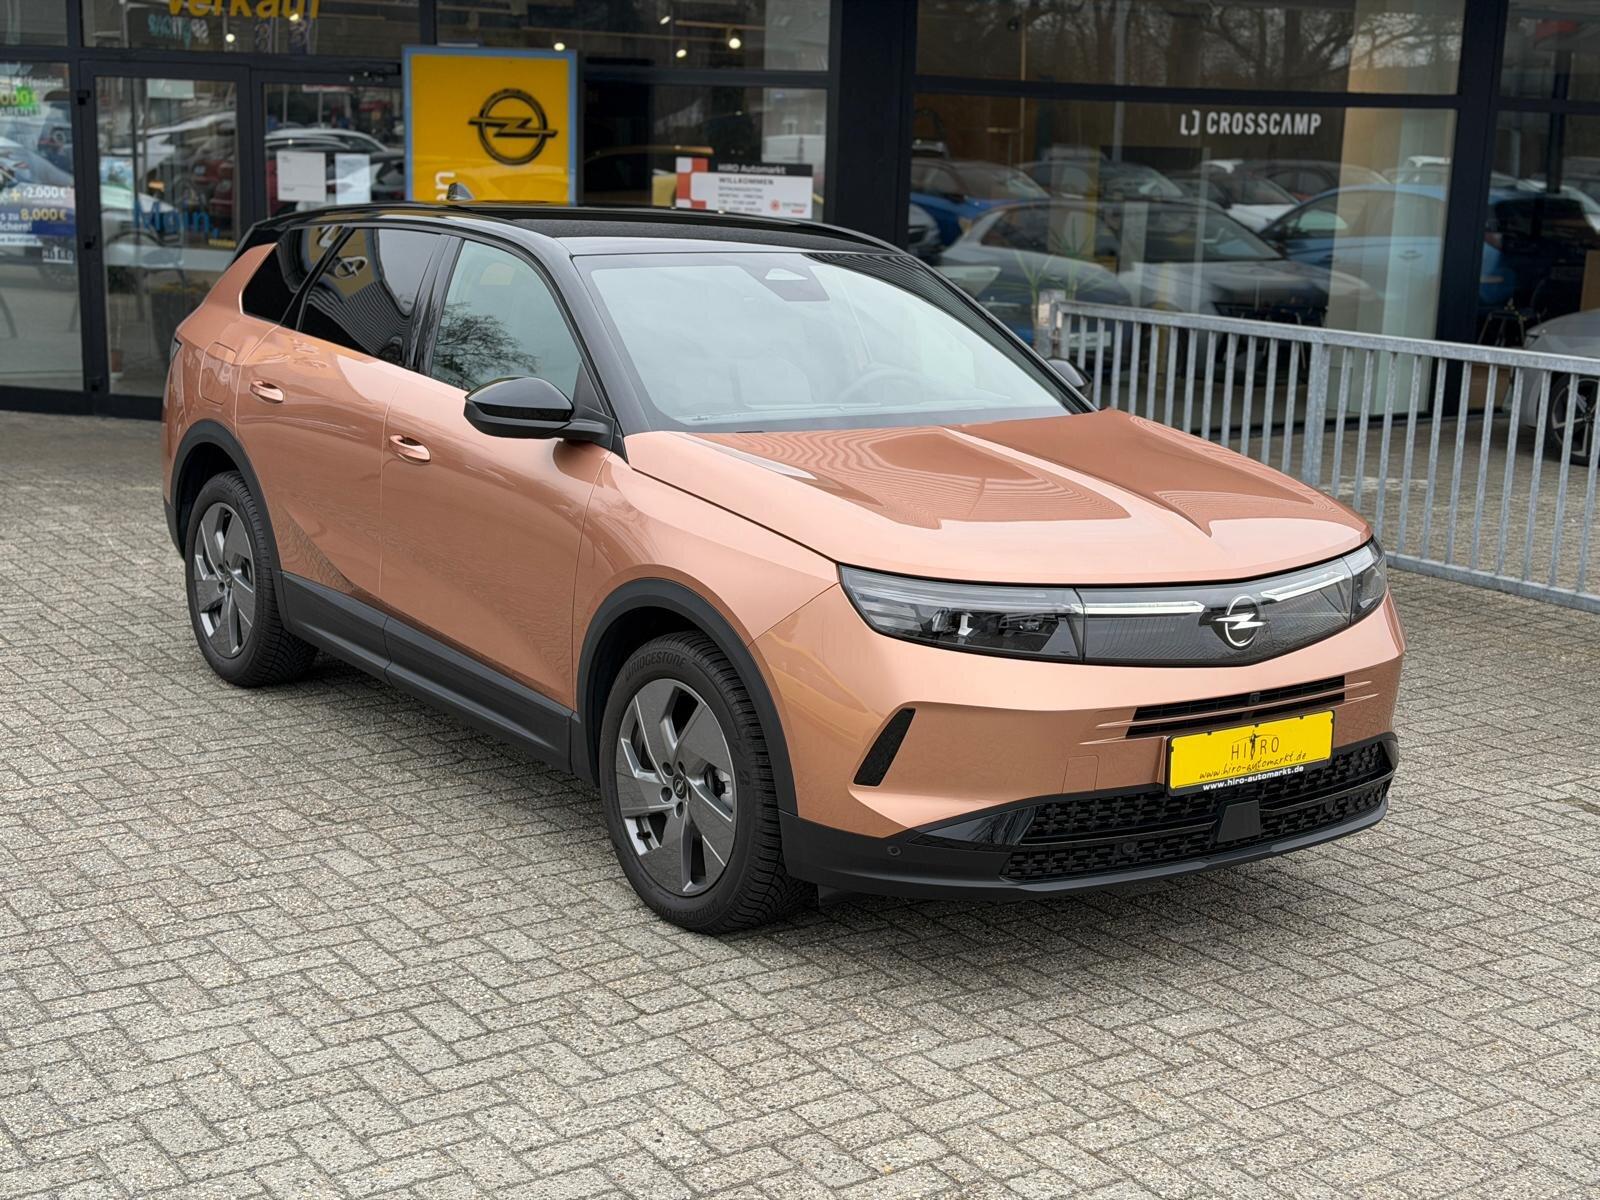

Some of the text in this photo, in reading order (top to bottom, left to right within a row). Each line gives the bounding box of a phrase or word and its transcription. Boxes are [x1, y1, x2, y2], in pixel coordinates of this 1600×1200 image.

[1206, 112, 1321, 135] CROSSCAMP
[719, 176, 774, 186] WILLKOMMEN
[740, 163, 786, 175] Automarkt
[1231, 736, 1280, 761] HIRO
[1200, 750, 1307, 779] www.hiro-automarkt.de
[1203, 765, 1304, 791] www.hiro-automarkt.de
